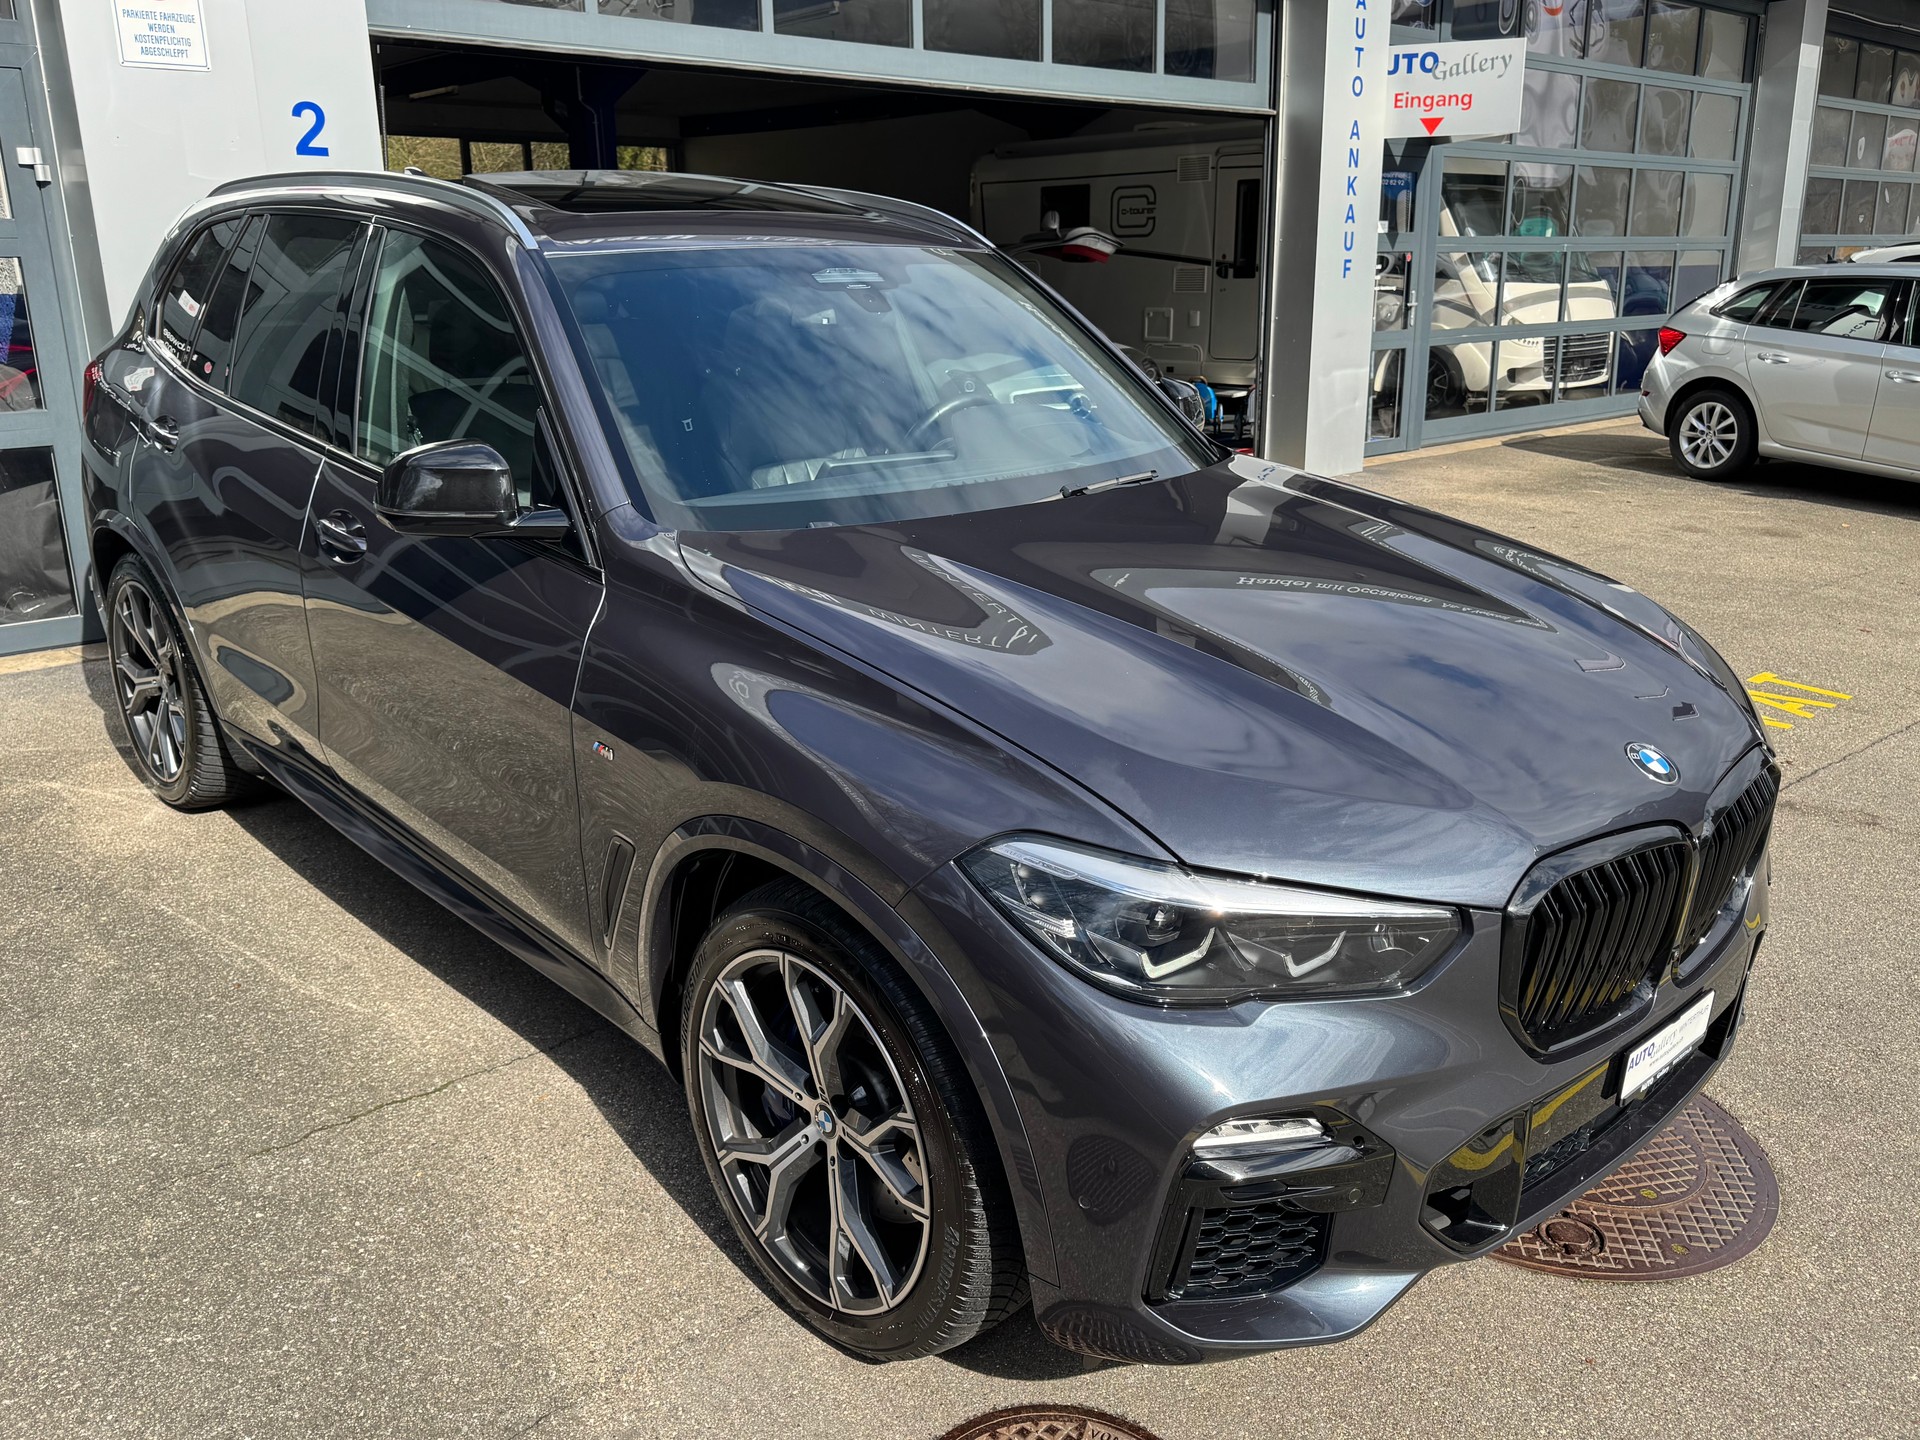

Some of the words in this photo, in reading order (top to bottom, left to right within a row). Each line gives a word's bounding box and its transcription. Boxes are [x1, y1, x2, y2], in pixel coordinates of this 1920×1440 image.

[122, 9, 158, 21] PARKIERTE
[159, 11, 196, 24] FAHRZEUGE
[148, 23, 176, 34] WERDEN
[133, 33, 192, 47] KOSTENPFLICHTIG
[140, 46, 189, 58] ABGESCHLEPPT
[1431, 51, 1513, 81] Gallery
[1393, 91, 1473, 113] Eingang
[291, 101, 330, 157] 2
[1343, 120, 1360, 279] ANKAUF
[1628, 1042, 1655, 1072] AUTO
